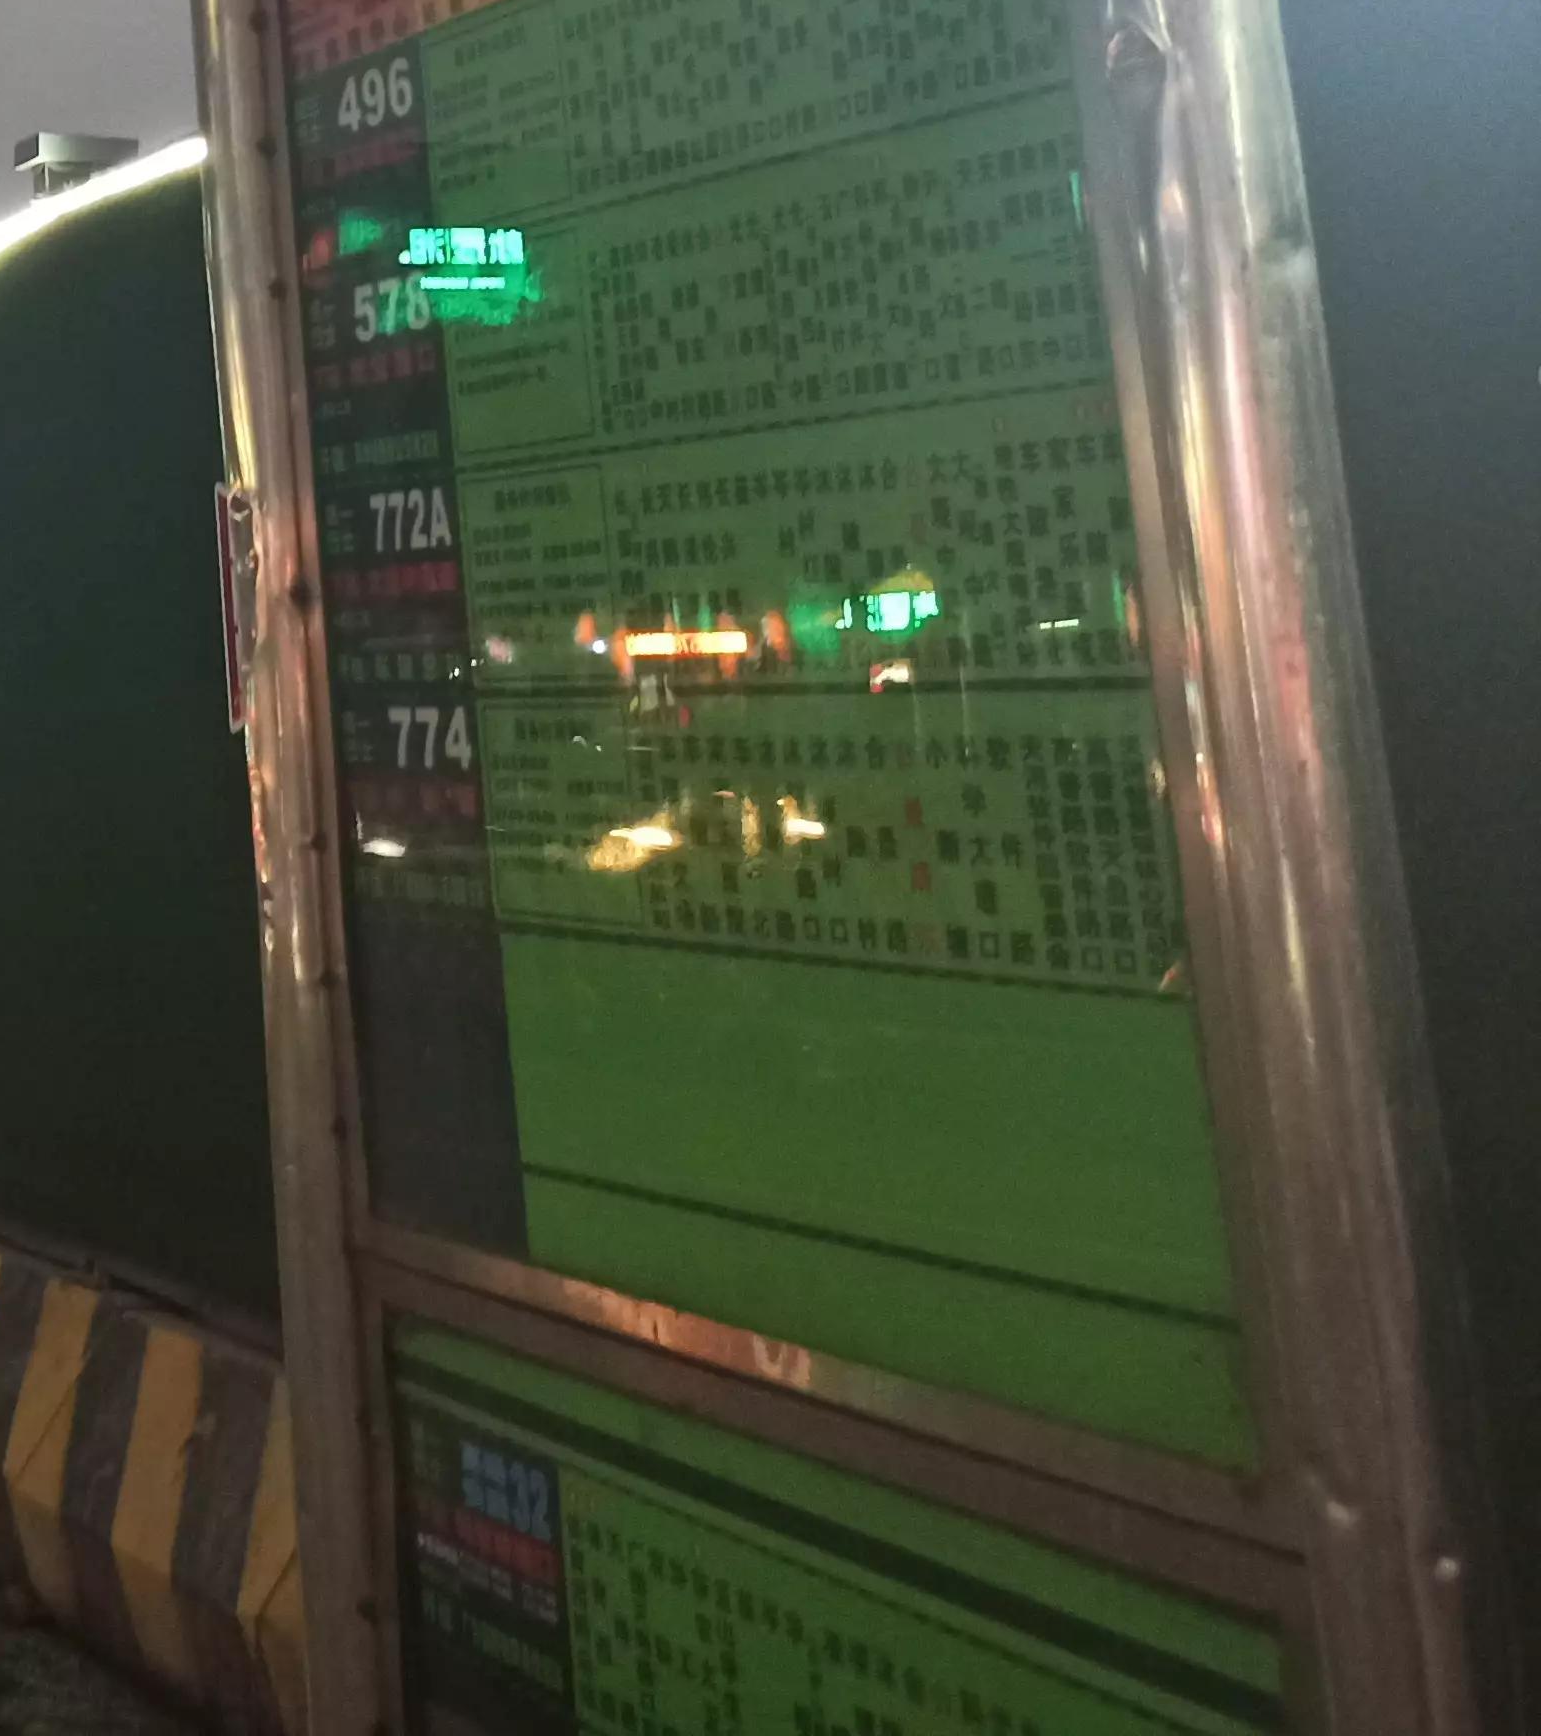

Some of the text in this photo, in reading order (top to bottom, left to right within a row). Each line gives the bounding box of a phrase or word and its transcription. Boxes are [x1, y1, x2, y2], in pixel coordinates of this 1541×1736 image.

[337, 57, 413, 132] 496
[354, 270, 431, 343] 578
[369, 486, 453, 554] 772A
[387, 705, 472, 770] 774
